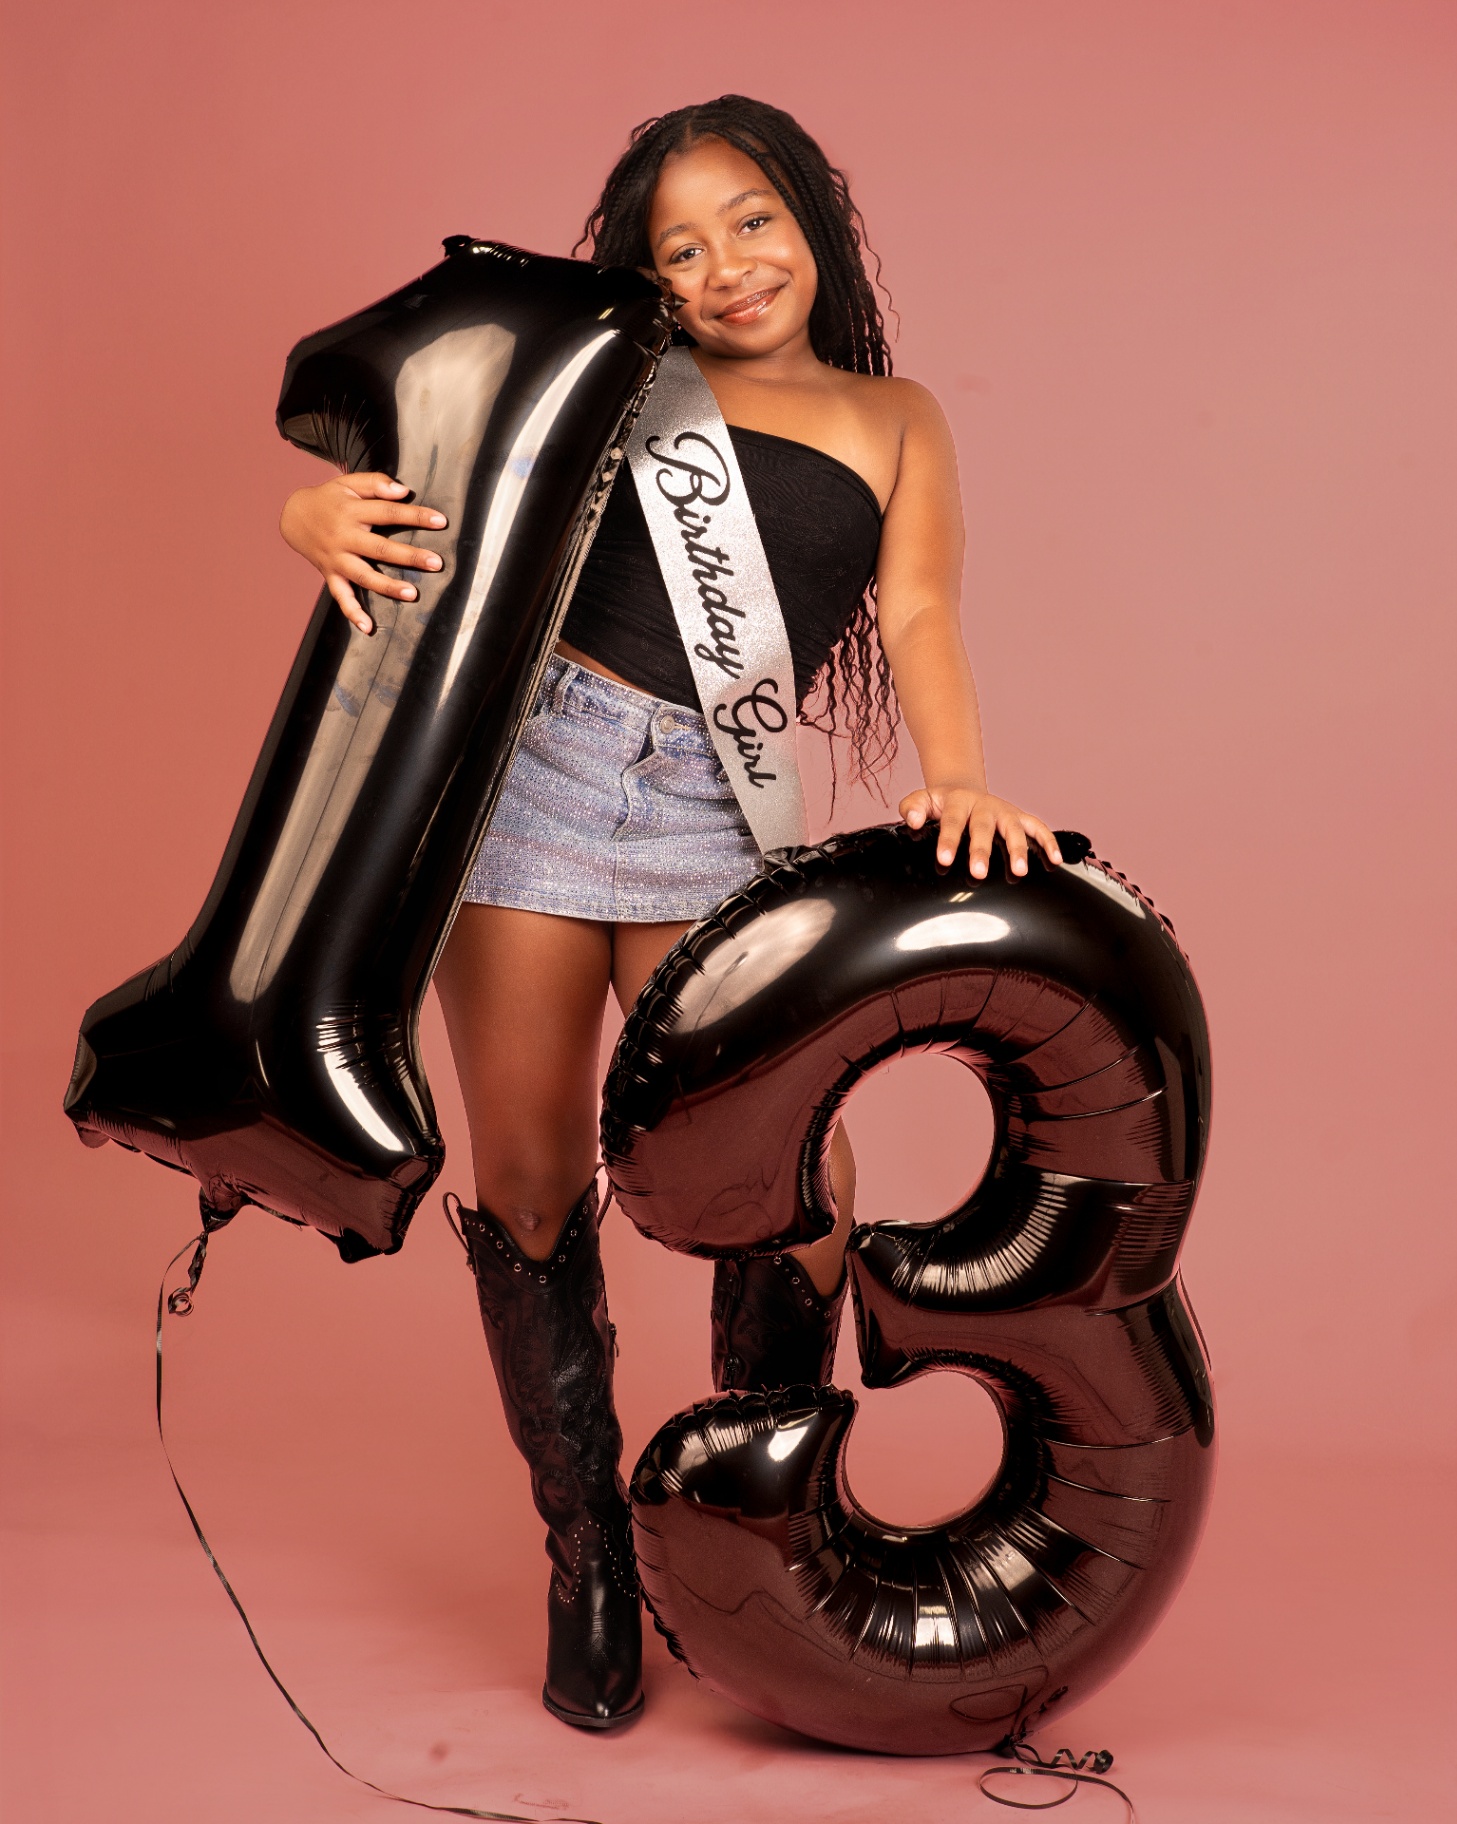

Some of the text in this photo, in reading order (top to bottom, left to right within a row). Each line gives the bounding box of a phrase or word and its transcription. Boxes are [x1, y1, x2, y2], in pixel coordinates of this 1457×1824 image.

[63, 234, 688, 1264] 1
[645, 431, 788, 789] Birthday Girl
[601, 822, 1216, 1757] 3
